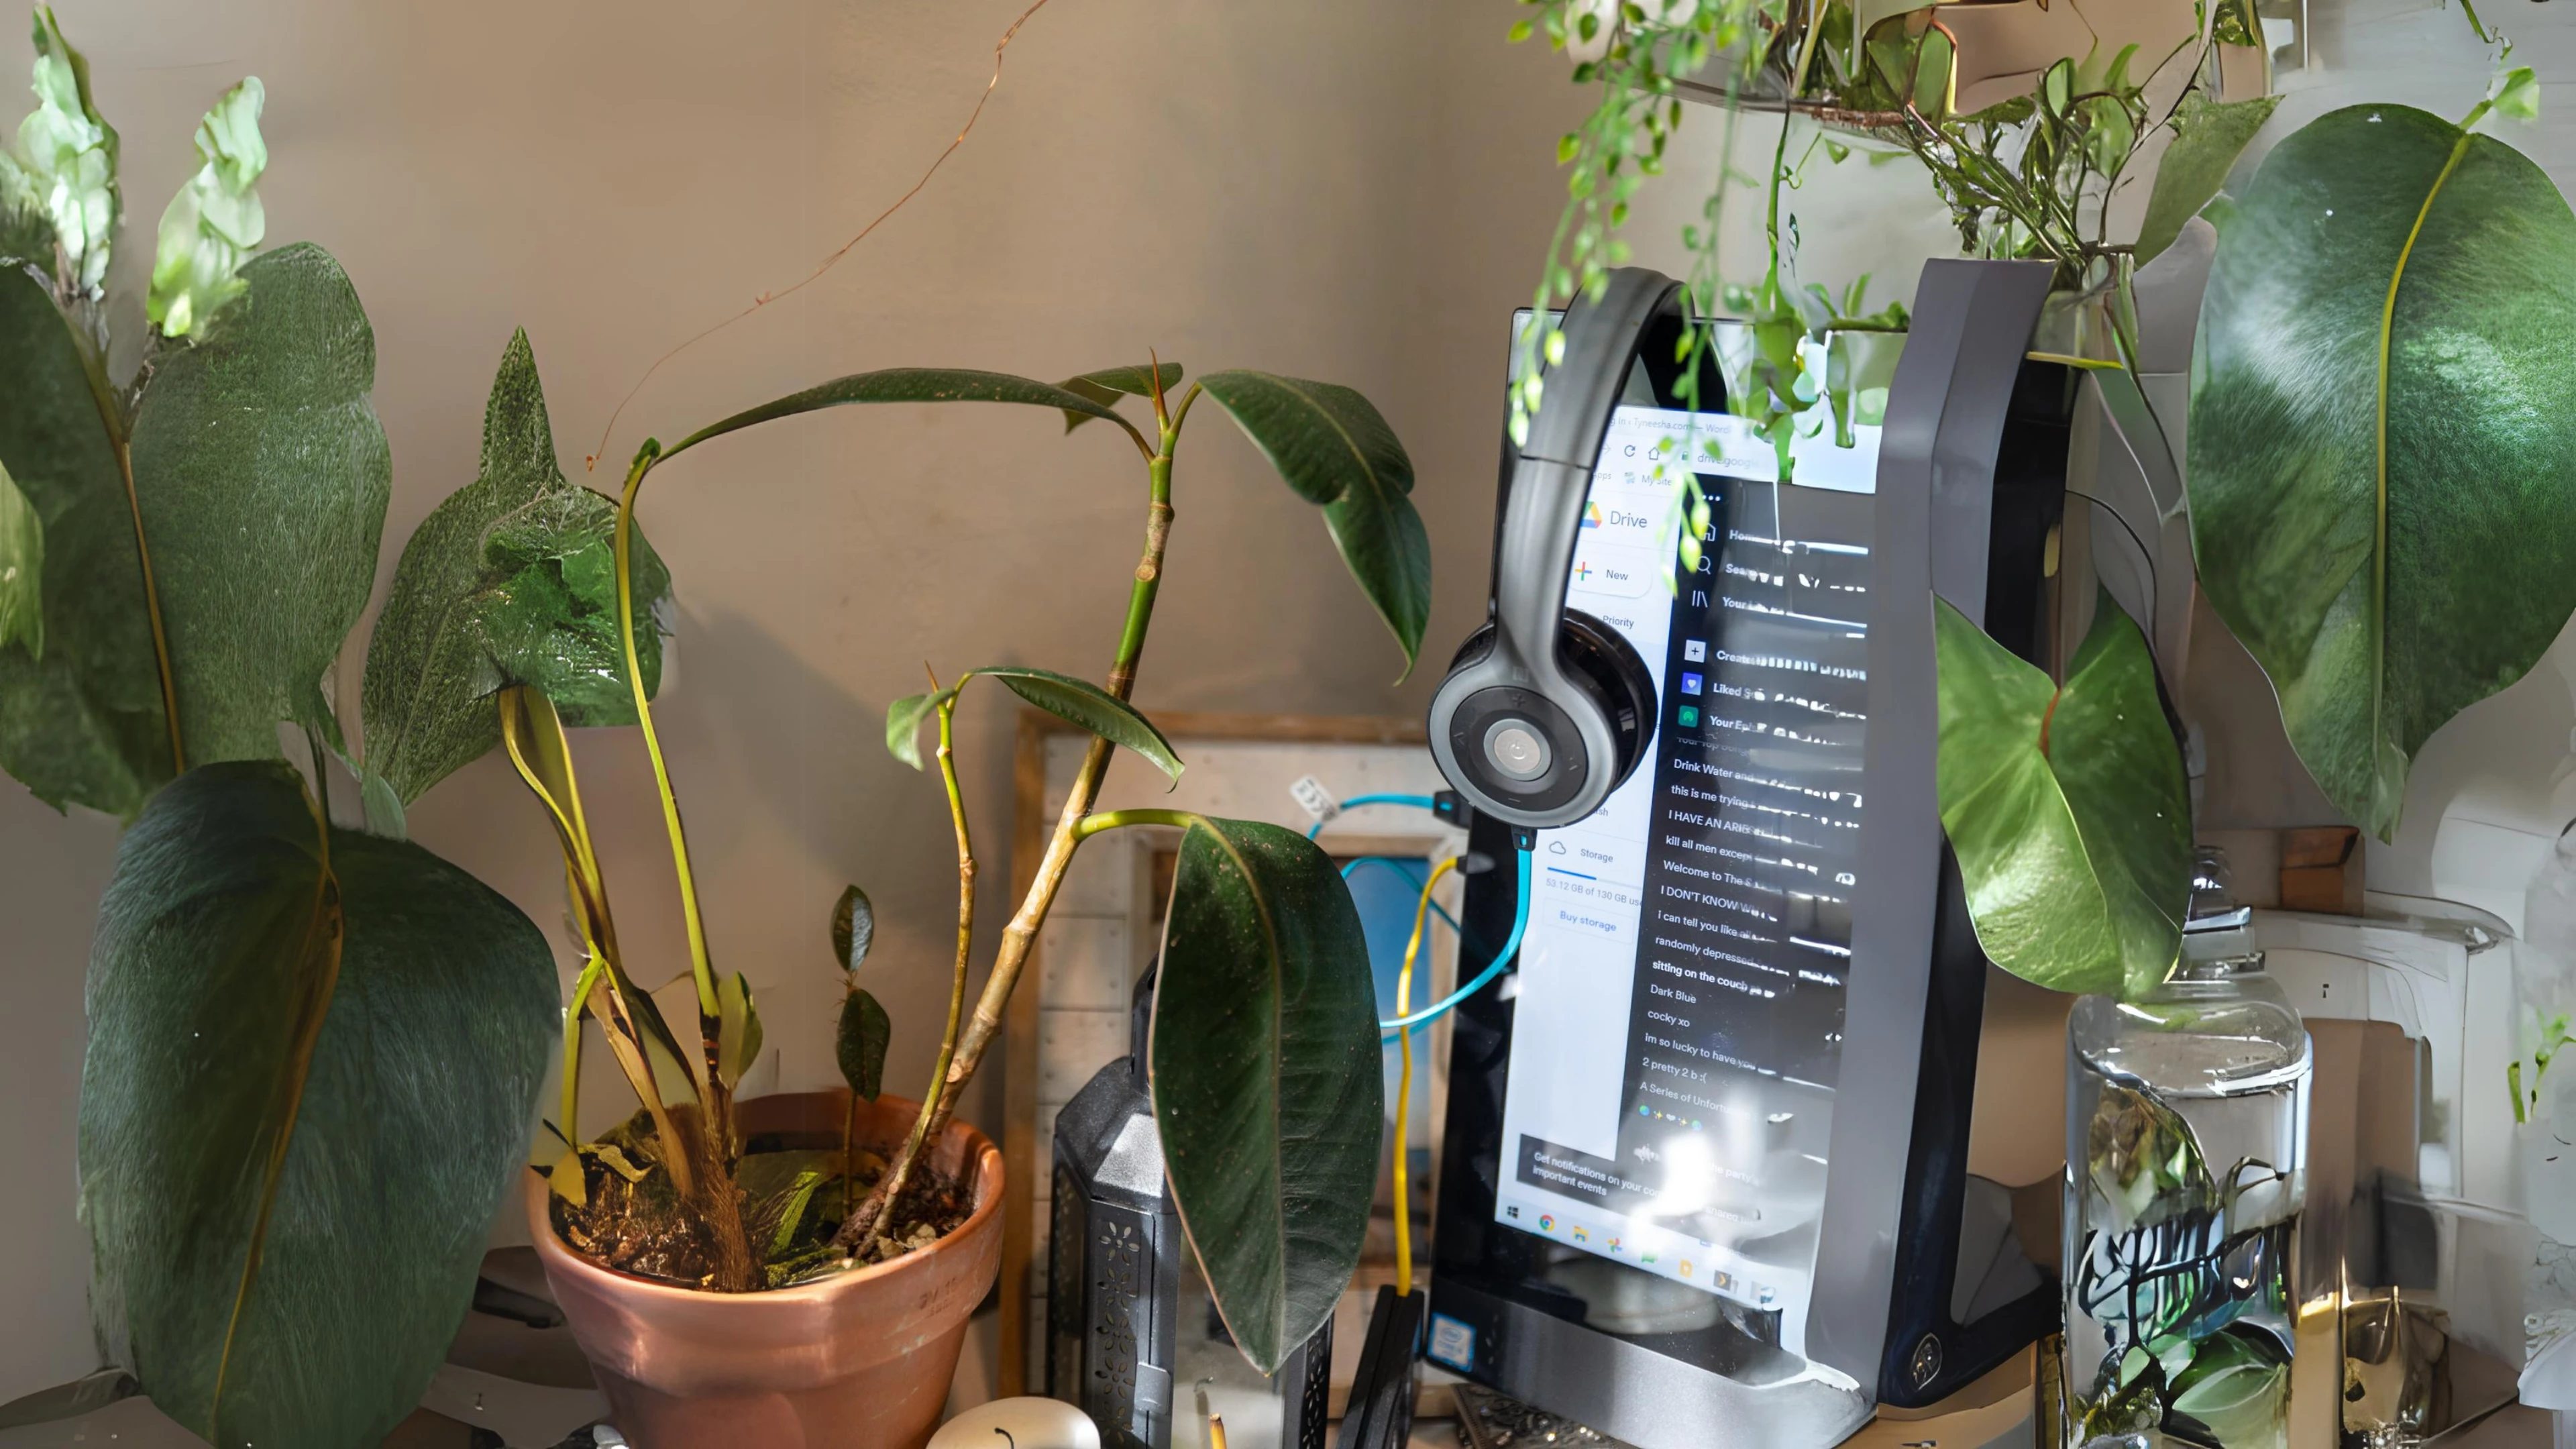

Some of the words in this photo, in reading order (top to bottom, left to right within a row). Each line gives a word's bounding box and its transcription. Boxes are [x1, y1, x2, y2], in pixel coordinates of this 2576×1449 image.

[1706, 423, 1732, 435] Word
[1642, 474, 1654, 486] My
[1610, 511, 1648, 528] Drive
[1606, 569, 1629, 580] New
[1722, 596, 1746, 609] Your
[1602, 615, 1635, 629] Priority
[1713, 683, 1741, 697] Liked
[1710, 715, 1733, 728] Your
[1674, 759, 1701, 772] Drink
[1703, 764, 1733, 778] Water
[1671, 785, 1688, 796] this
[1690, 788, 1699, 798] is
[1701, 792, 1717, 802] me
[1719, 794, 1748, 810] trying
[1668, 810, 1672, 819] I
[1674, 811, 1703, 826] HAVE
[1705, 817, 1722, 828] AN
[1666, 835, 1680, 847] kill
[1682, 839, 1693, 849] all
[1695, 843, 1717, 854] men
[1580, 849, 1613, 863] Storage
[1664, 860, 1709, 878] Welcome
[1711, 871, 1722, 881] to
[1724, 873, 1743, 885] The
[1546, 878, 1569, 891] 53.12
[1571, 883, 1584, 894] GB
[1585, 888, 1595, 896] of
[1597, 890, 1613, 900] 130
[1614, 893, 1627, 904] GB
[1660, 885, 1664, 894] I
[1666, 887, 1701, 902] DON'T
[1702, 894, 1739, 910] KNOW
[1560, 910, 1578, 924] Buy
[1580, 917, 1617, 932] storage
[1658, 910, 1662, 919] i
[1663, 912, 1681, 924] can
[1683, 917, 1698, 927] tell
[1700, 922, 1718, 932] you
[1720, 924, 1738, 936] like
[1655, 936, 1702, 955] randomly
[1652, 961, 1682, 977] sitting
[1684, 969, 1697, 979] on
[1699, 972, 1715, 983] the
[1717, 977, 1748, 992] couch
[1650, 984, 1674, 998] Dark
[1675, 990, 1697, 1004] Blue
[1648, 1010, 1677, 1026] cocky
[1678, 1018, 1690, 1028] xo
[1645, 1032, 1657, 1044] im
[1659, 1038, 1670, 1048] so
[1672, 1040, 1699, 1057] lucky
[1700, 1048, 1710, 1058] to
[1712, 1051, 1736, 1065] have
[1642, 1058, 1649, 1067] 2
[1651, 1061, 1680, 1077] pretty
[1681, 1068, 1688, 1077] 2
[1690, 1070, 1698, 1080] b
[1640, 1081, 1648, 1091] A
[1649, 1083, 1679, 1099] Series
[1680, 1093, 1691, 1103] of
[1533, 1165, 1576, 1187] important
[1577, 1180, 1607, 1195] events
[1534, 1152, 1550, 1164] Get
[1552, 1158, 1606, 1182] notifications
[1608, 1176, 1619, 1186] on
[1621, 1180, 1642, 1192] your
